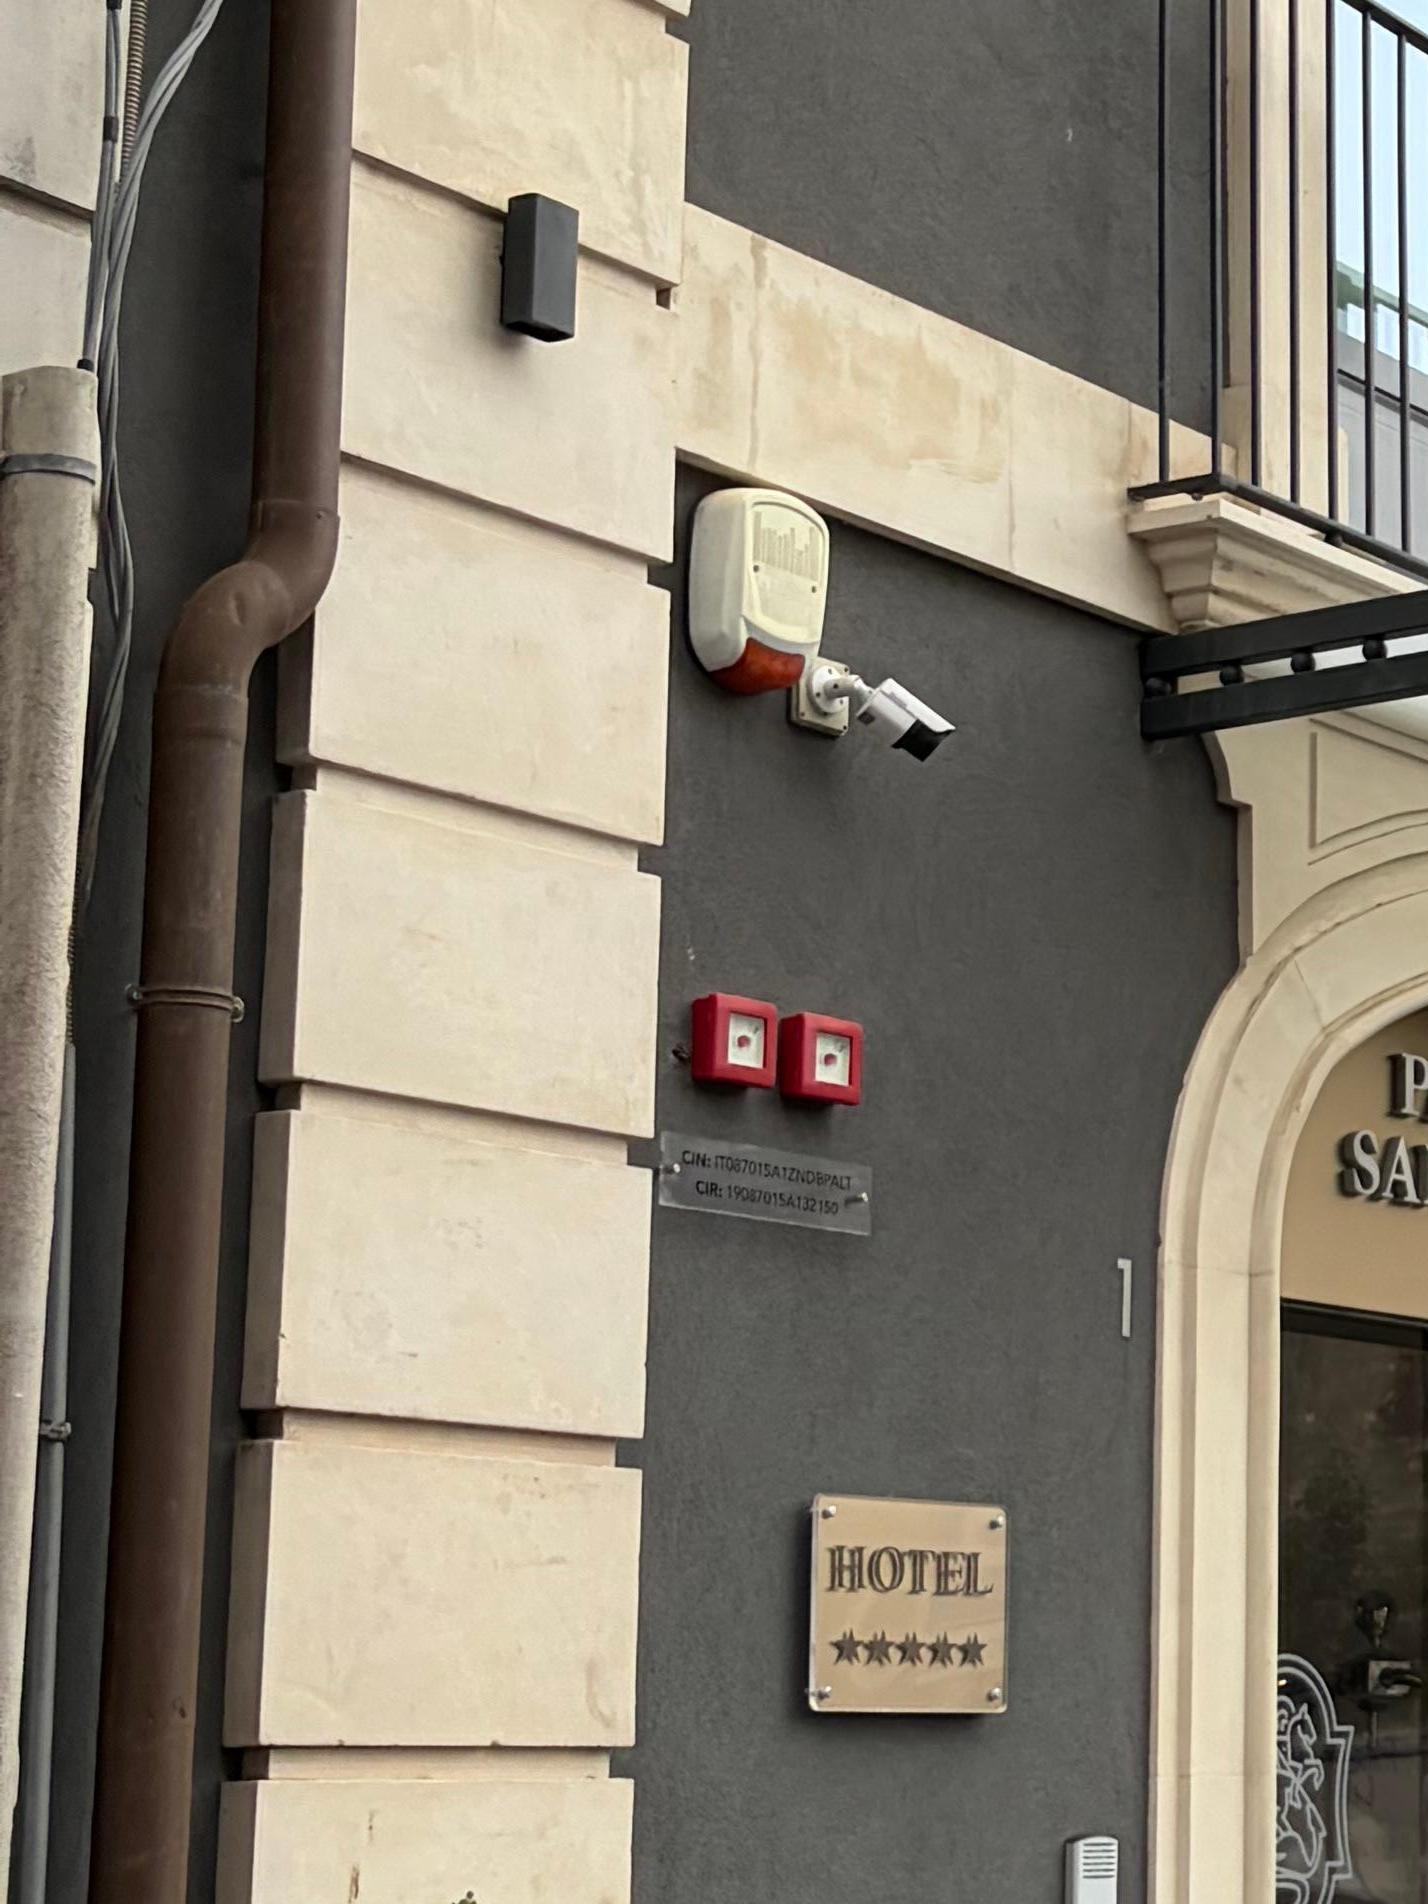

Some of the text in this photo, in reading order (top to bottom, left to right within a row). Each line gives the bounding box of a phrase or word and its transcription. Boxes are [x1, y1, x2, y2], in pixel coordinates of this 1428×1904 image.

[682, 1150, 711, 1169] CIN:
[695, 1180, 722, 1198] CIR:
[1117, 1257, 1132, 1337] 1
[826, 1545, 994, 1596] HOTEL
